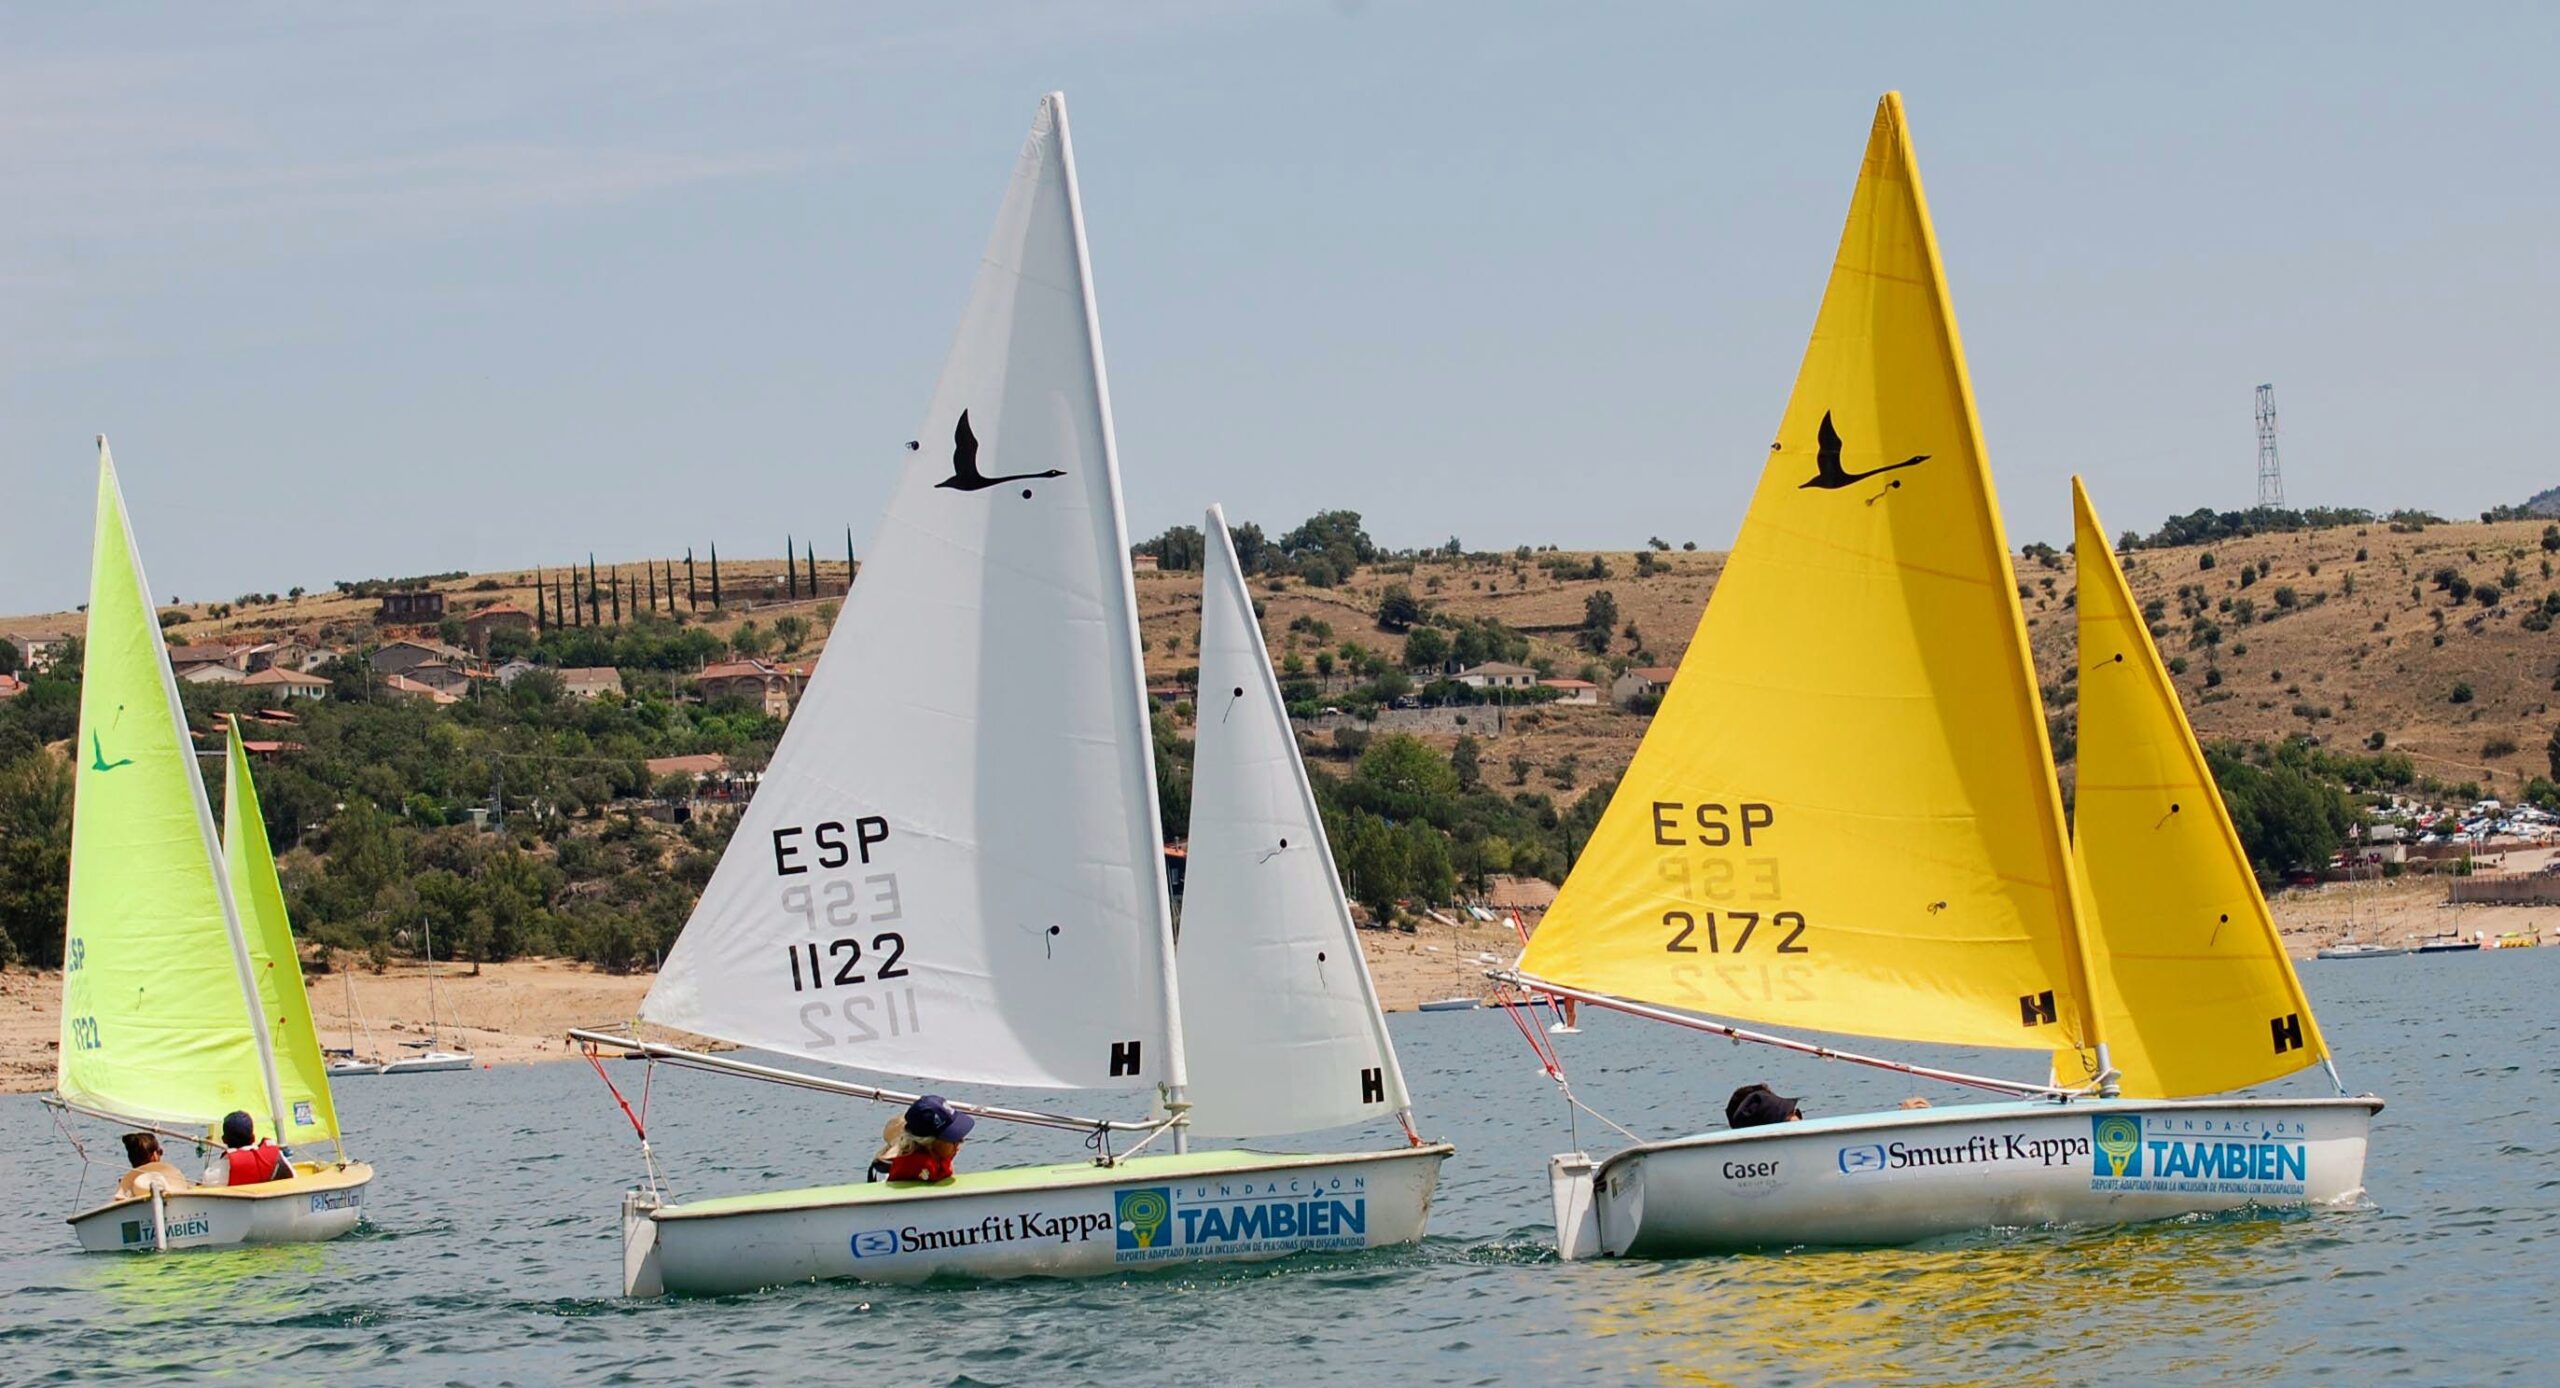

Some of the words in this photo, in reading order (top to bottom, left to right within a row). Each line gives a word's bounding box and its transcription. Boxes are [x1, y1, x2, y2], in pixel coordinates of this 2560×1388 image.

[1653, 801, 1774, 847] ESP
[773, 816, 889, 875] ESP
[1663, 911, 1808, 953] 2172
[789, 932, 909, 992] 1122
[2146, 1119, 2305, 1133] FUNDACIÓN
[1722, 1161, 1780, 1180] Caser
[1889, 1136, 1999, 1169] Smurfit
[2002, 1133, 2090, 1167] Kappa
[2147, 1131, 2305, 1181] TAMBIÉN
[1176, 1177, 1364, 1199] FUNDACIÓN
[901, 1216, 1015, 1253] Smurfit
[1019, 1212, 1113, 1243] Kappa
[1177, 1188, 1366, 1244] TAMBIÉN
